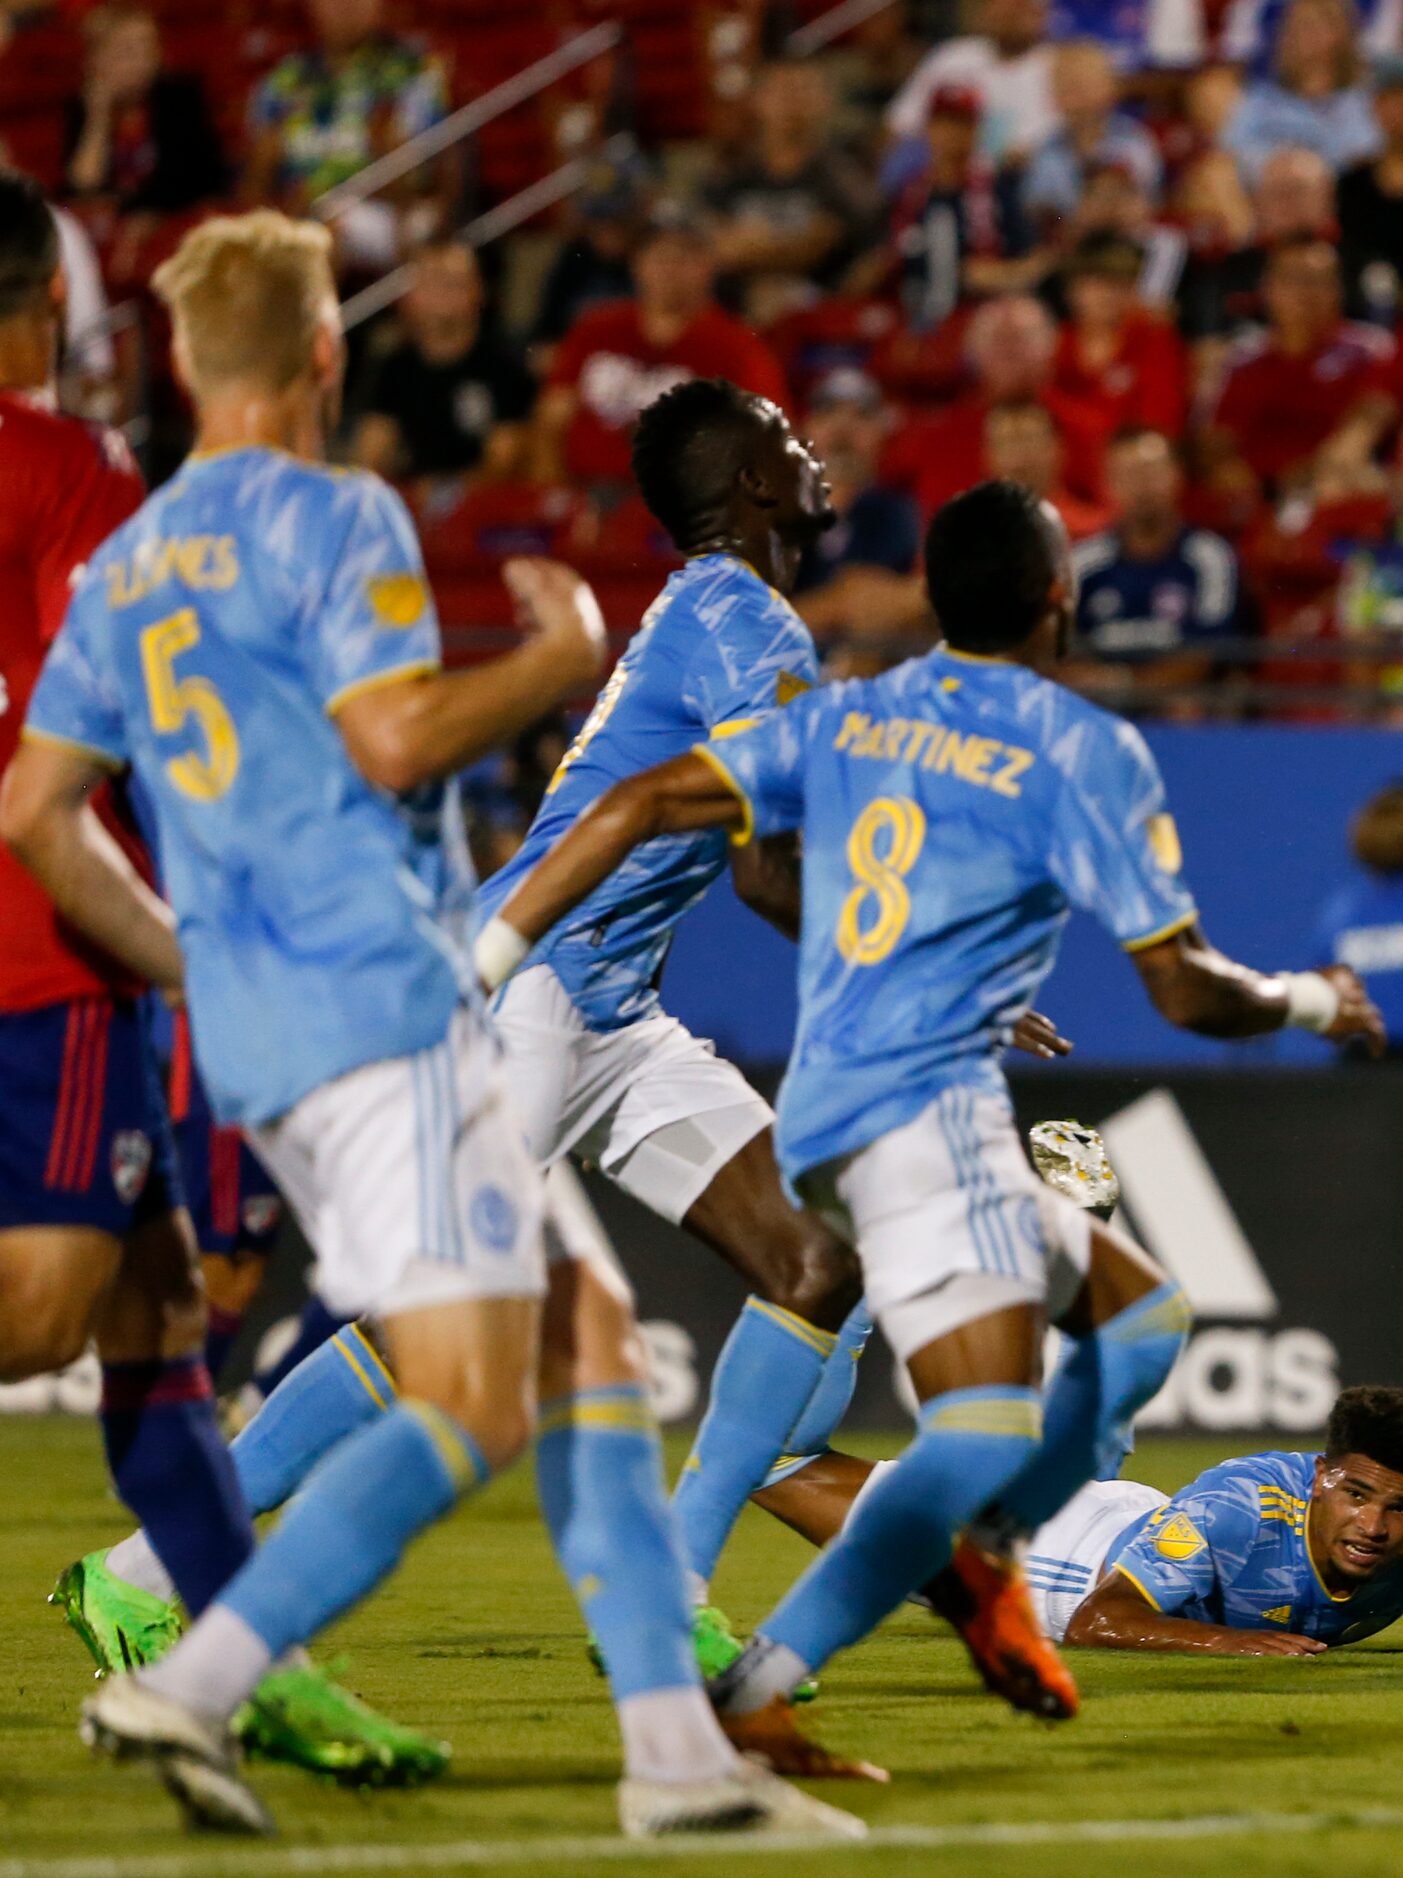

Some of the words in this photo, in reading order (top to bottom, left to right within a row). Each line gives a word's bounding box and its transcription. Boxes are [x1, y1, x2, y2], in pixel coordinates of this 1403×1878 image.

[139, 606, 240, 801] 5
[834, 710, 1036, 798] MARTINEZ
[836, 796, 927, 966] 8
